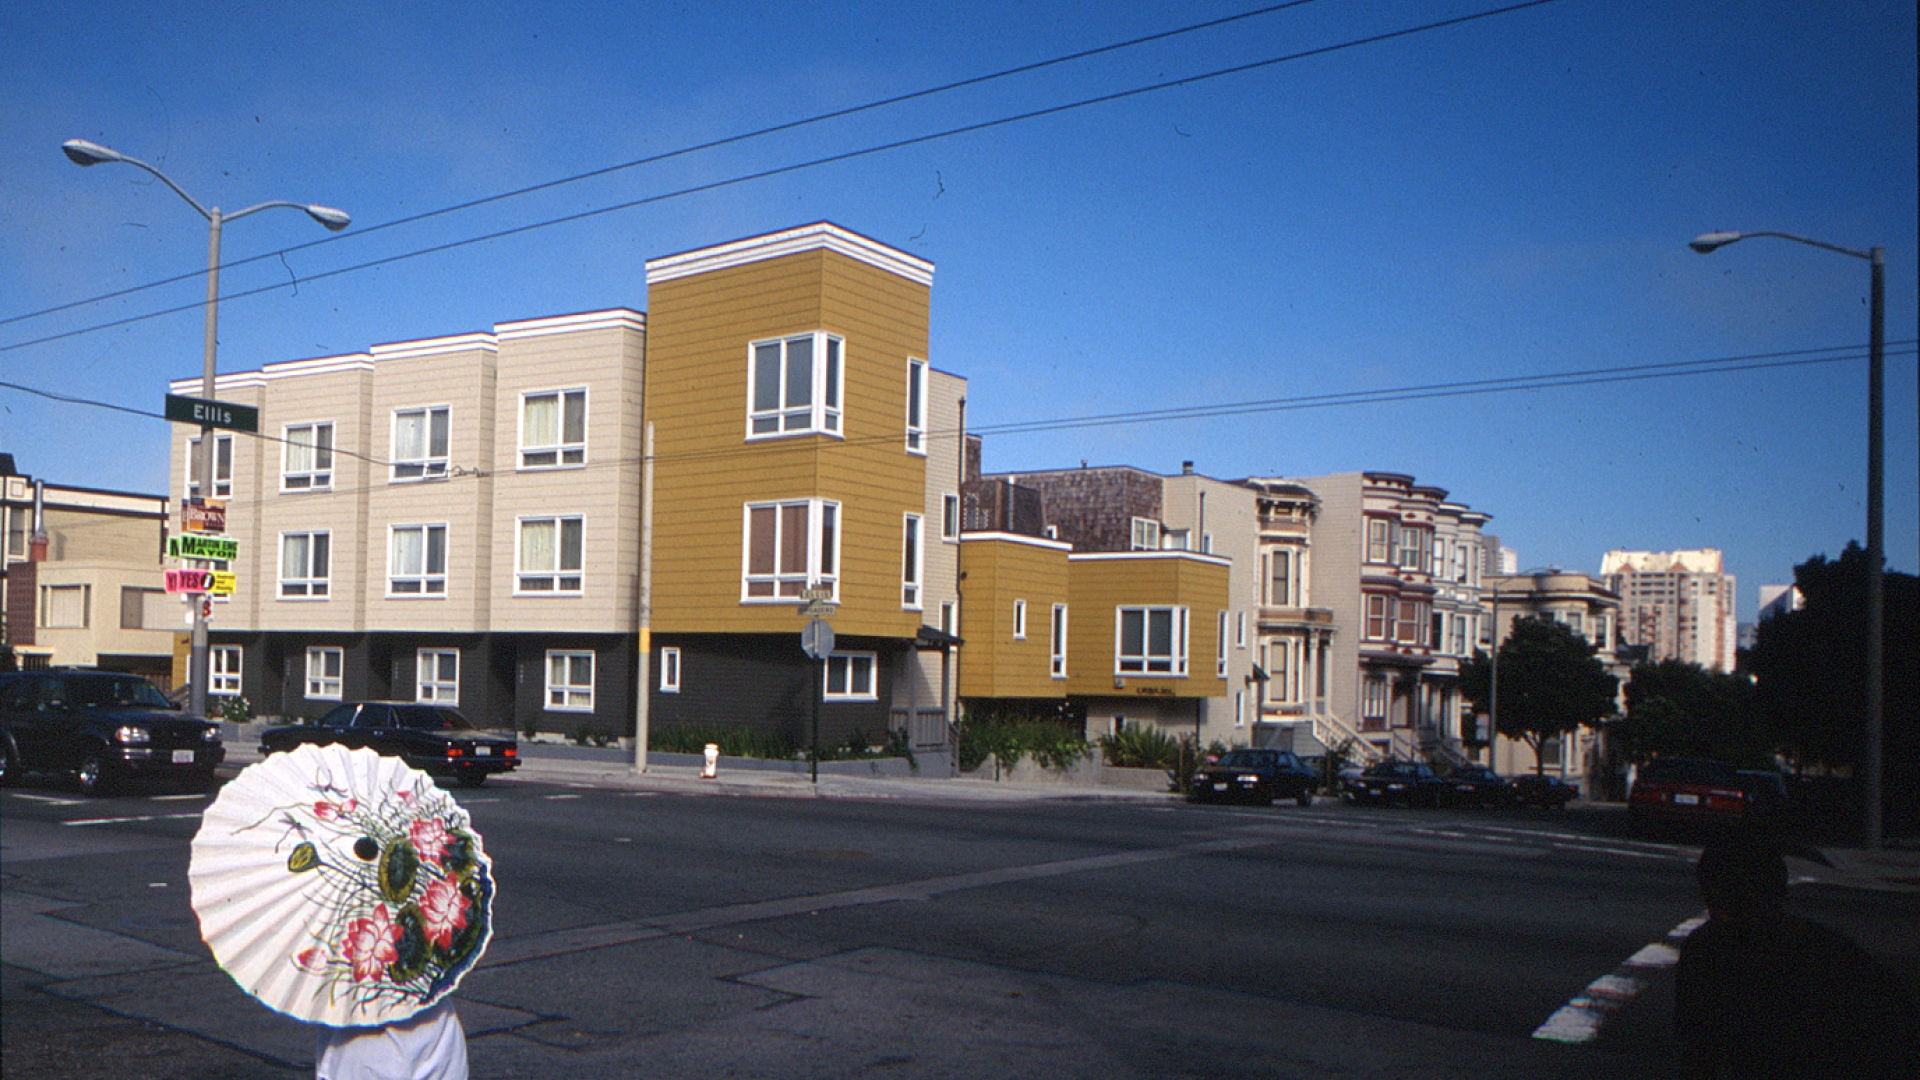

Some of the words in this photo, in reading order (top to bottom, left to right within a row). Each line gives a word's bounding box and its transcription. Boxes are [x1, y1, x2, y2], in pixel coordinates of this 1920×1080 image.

[194, 404, 232, 424] Ellis
[190, 508, 225, 523] BROWN
[182, 536, 220, 554] MARTIN
[179, 571, 200, 588] YES
